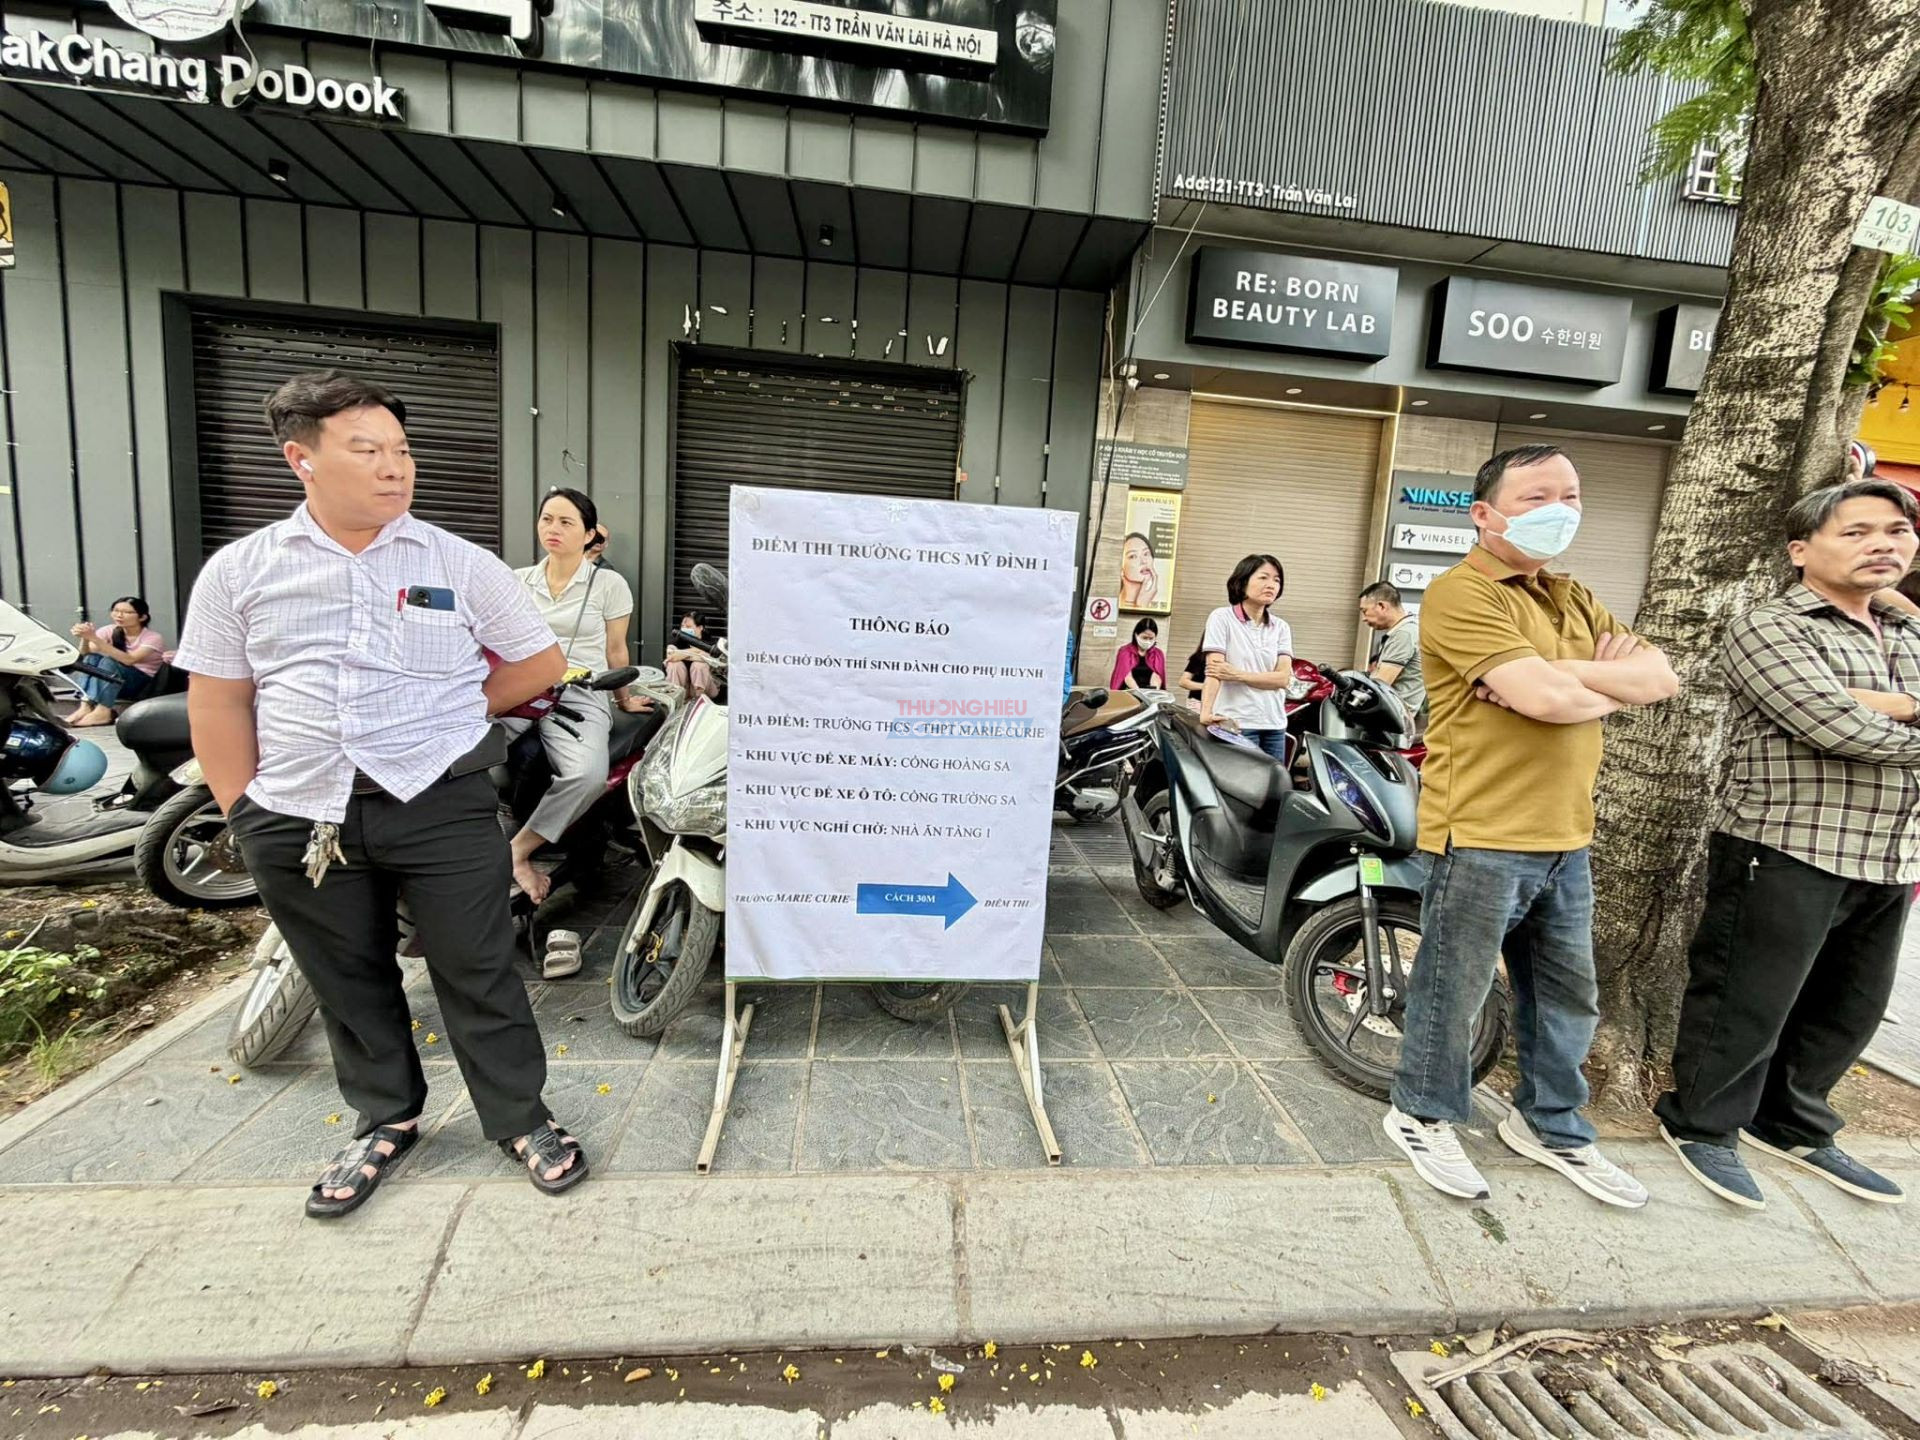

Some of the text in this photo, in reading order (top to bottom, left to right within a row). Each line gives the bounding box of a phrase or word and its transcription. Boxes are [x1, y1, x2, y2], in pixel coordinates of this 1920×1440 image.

[774, 8, 797, 27] 122
[810, 14, 831, 32] TT3
[836, 12, 871, 38] TRẦN
[876, 21, 904, 43] VĂN
[933, 30, 952, 50] HÀ
[957, 33, 981, 58] NỘI
[0, 30, 208, 102] akChang
[1272, 182, 1302, 202] Trần
[1305, 189, 1332, 206] Văn
[1335, 192, 1357, 209] Lai
[1875, 205, 1911, 233] 103
[1236, 271, 1359, 303] RE: BORN
[1213, 298, 1376, 334] BEAUTY LAB
[1468, 310, 1602, 350] SOO 수한의원
[1689, 329, 1713, 351] BL
[1404, 486, 1472, 507] VINASE
[1421, 533, 1466, 545] VINASEL
[752, 535, 1048, 571] ĐIỂM THI TRƯỜNG THCS MỸ ĐÌNH 1
[849, 616, 950, 636] THÔNG BÁO
[746, 651, 1043, 678] ĐIỂM CHỜ ĐÓN THÍ SINH DÀNH CHO PHỤ HUYNH
[738, 713, 763, 727] ĐỊA
[767, 713, 809, 728] ĐIỂM:
[813, 716, 871, 731] TRƯỜNG
[875, 721, 910, 732] THCS
[922, 723, 956, 735] THPT
[959, 725, 1002, 737] MARIE
[1006, 727, 1045, 738] CURIE
[746, 750, 777, 761] KHU
[781, 751, 812, 765] VỰC
[815, 752, 834, 764] ĐỂ
[838, 754, 856, 765] XE
[860, 753, 897, 767] MÁY:
[901, 755, 939, 769] CỔNG
[943, 757, 990, 771] HOÀNG
[994, 761, 1010, 771] SA
[745, 784, 776, 795] KHU
[780, 785, 811, 799] VỰC
[814, 786, 833, 798] ĐỂ
[837, 788, 855, 799] XE
[859, 787, 869, 800] Ô
[873, 788, 896, 801] TÔ:
[900, 790, 938, 803] CỔNG
[942, 792, 997, 805] TRƯỜNG
[1000, 795, 1017, 805] SA
[745, 819, 775, 830] KHU
[780, 820, 810, 833] VỰC
[813, 821, 848, 833] NGHỈ
[852, 822, 887, 835] CHỜ:
[891, 823, 919, 836] NHÀ
[923, 824, 942, 837] ĂN
[946, 825, 982, 838] TẦNG
[986, 828, 991, 838] 1
[775, 893, 813, 903] MARIE
[814, 894, 850, 904] CURIE
[885, 891, 935, 903] CÁCH 30M
